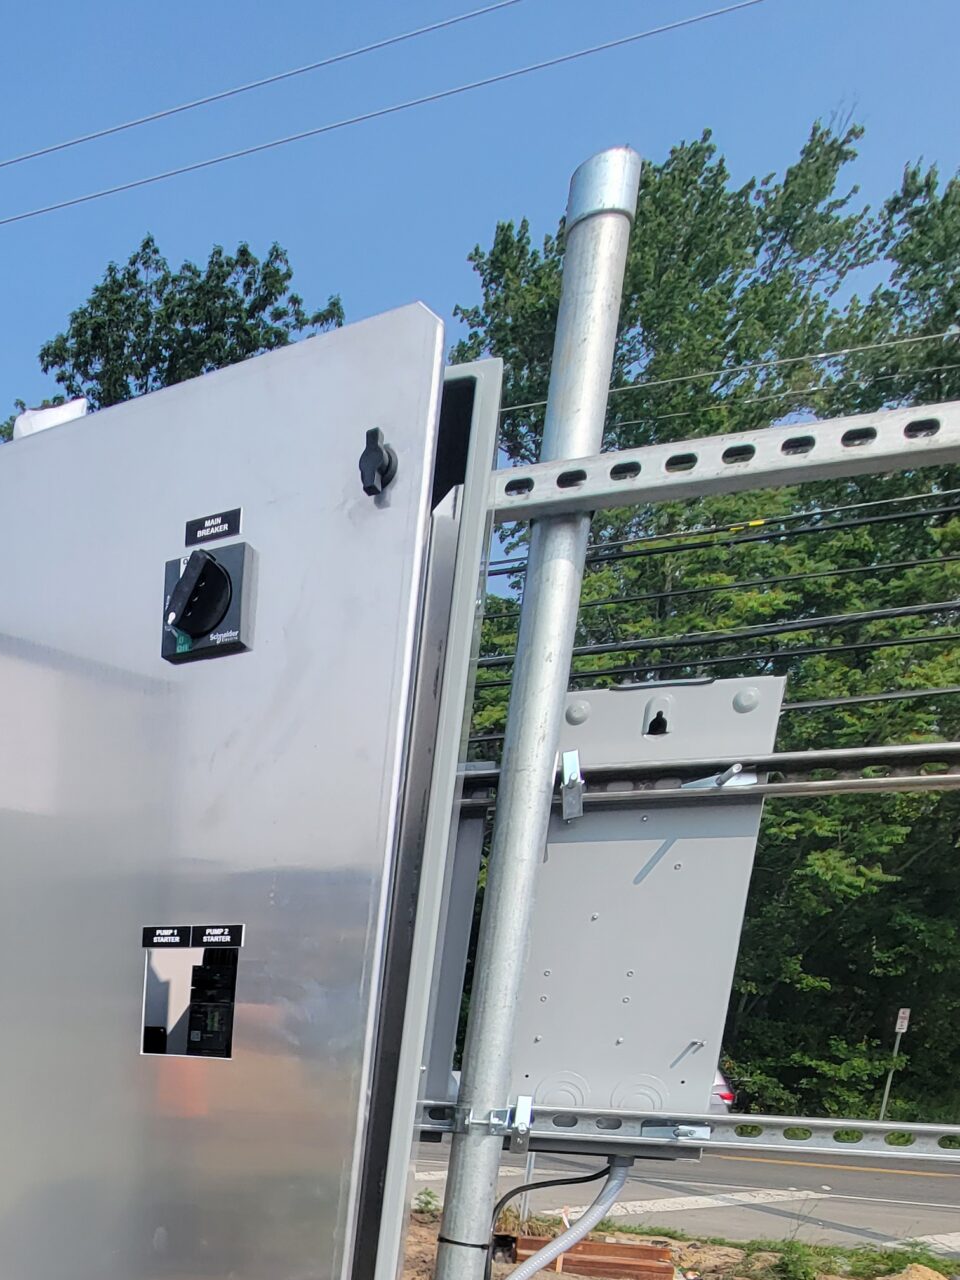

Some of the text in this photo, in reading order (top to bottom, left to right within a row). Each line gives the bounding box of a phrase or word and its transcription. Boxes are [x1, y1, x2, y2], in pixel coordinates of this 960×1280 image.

[204, 516, 222, 527] MAIN
[196, 523, 229, 538] BREAKER
[209, 630, 239, 644] Schneider
